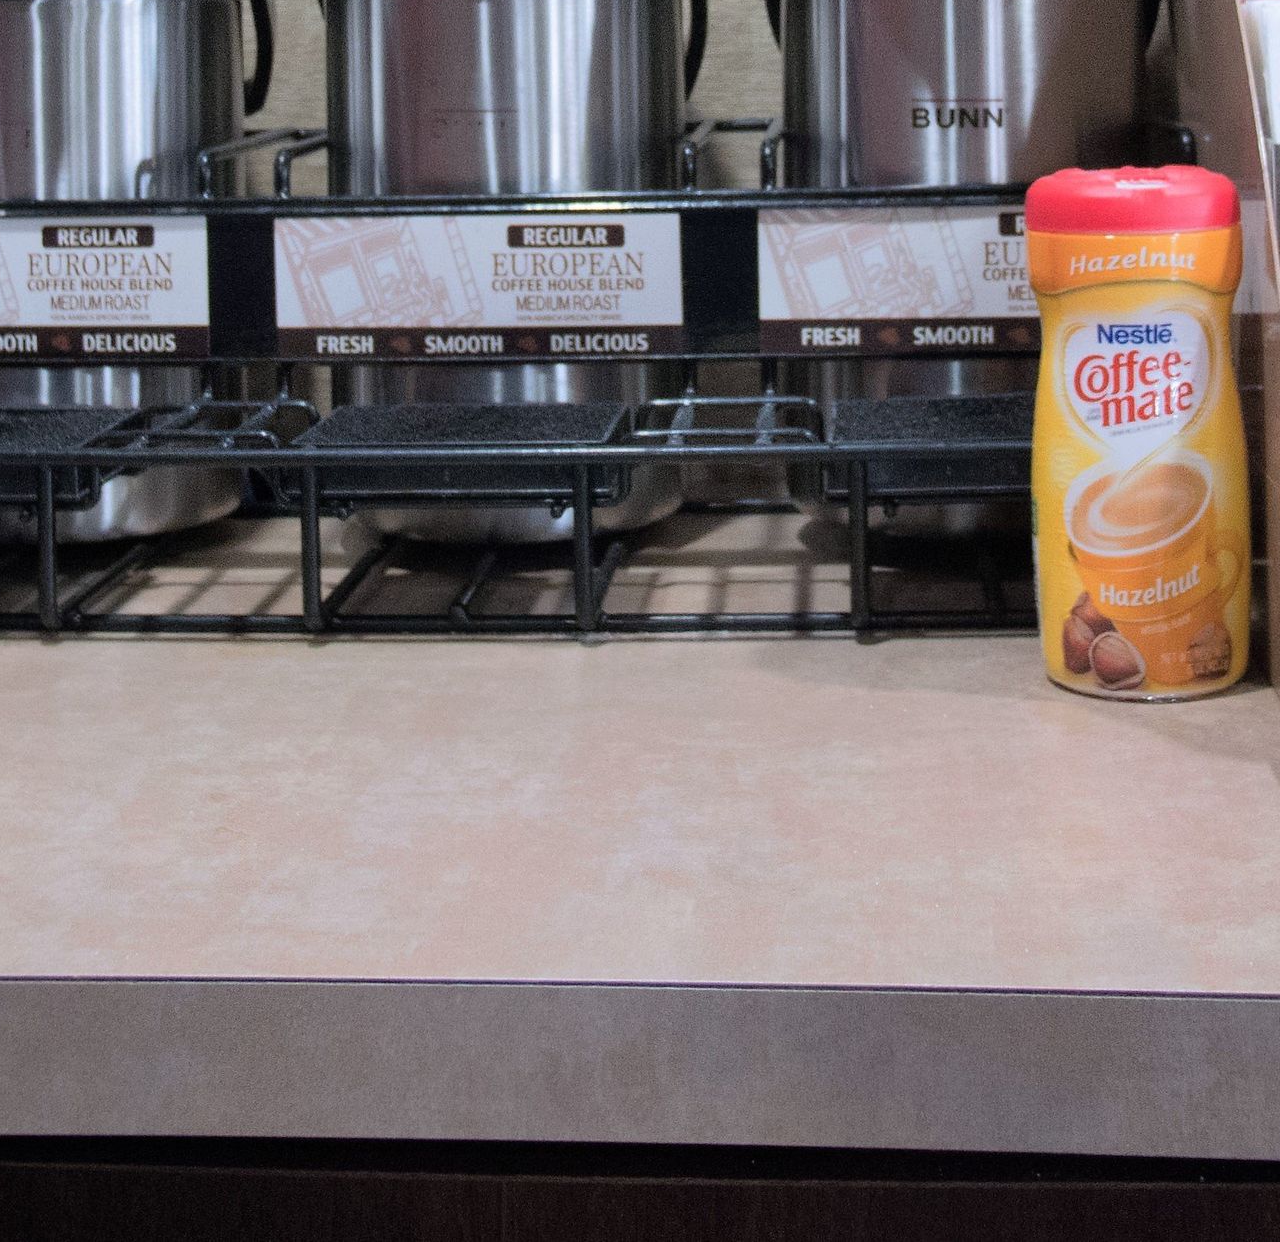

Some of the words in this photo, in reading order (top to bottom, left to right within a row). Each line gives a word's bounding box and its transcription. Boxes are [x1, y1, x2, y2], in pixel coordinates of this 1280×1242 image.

[911, 108, 1004, 128] BUNN
[58, 228, 139, 247] REGULAR
[523, 227, 607, 246] REGULAR
[27, 252, 173, 277] EUROPEAN
[491, 252, 644, 277] EUROPEAN
[1070, 246, 1196, 276] Hazelnut
[982, 267, 1027, 281] COFFE
[27, 278, 75, 291] COFFEE
[81, 279, 122, 291] HOUSE
[129, 278, 173, 291] BLEND
[491, 279, 543, 292] COFFEE
[548, 279, 594, 291] HOUSE
[599, 278, 644, 290] BLEND
[50, 294, 102, 310] MEDIUM
[105, 294, 150, 310] ROAST
[516, 294, 570, 311] MEDIUM
[574, 294, 622, 310] ROAST
[83, 333, 177, 353] DELICIOUS
[317, 334, 374, 354] FRESH
[425, 334, 503, 353] SMOOTH
[550, 332, 648, 352] DELICIOUS
[801, 327, 861, 346] FRESH
[913, 326, 994, 345] SMOOTH
[1097, 323, 1173, 345] Nestlé
[1102, 380, 1194, 427] mate
[1099, 565, 1201, 606] Hazelnut
